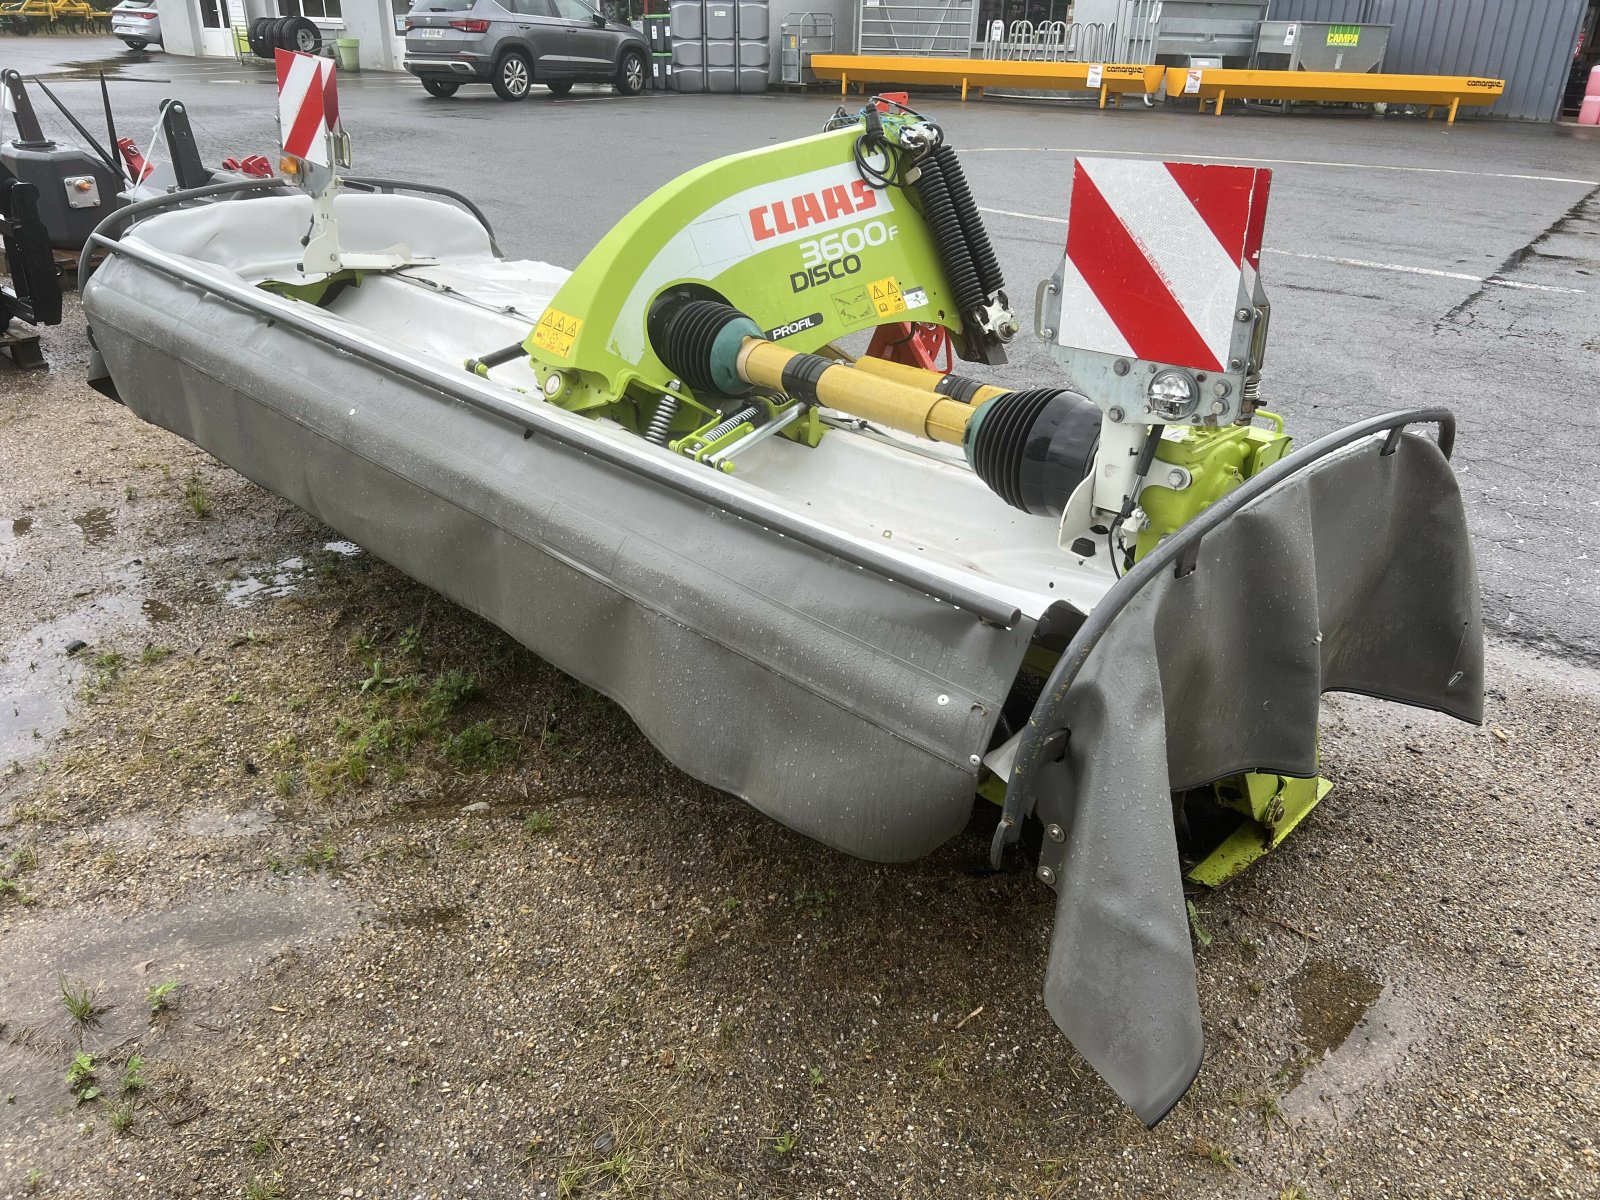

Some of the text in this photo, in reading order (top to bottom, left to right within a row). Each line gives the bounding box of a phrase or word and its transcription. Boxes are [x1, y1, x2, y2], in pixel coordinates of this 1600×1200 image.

[1327, 33, 1358, 44] CAMPA
[1106, 66, 1144, 75] camargue
[1467, 80, 1503, 89] camargue
[749, 179, 877, 241] CLAAS
[789, 254, 862, 294] DISCO
[772, 317, 815, 340] PROFIL
